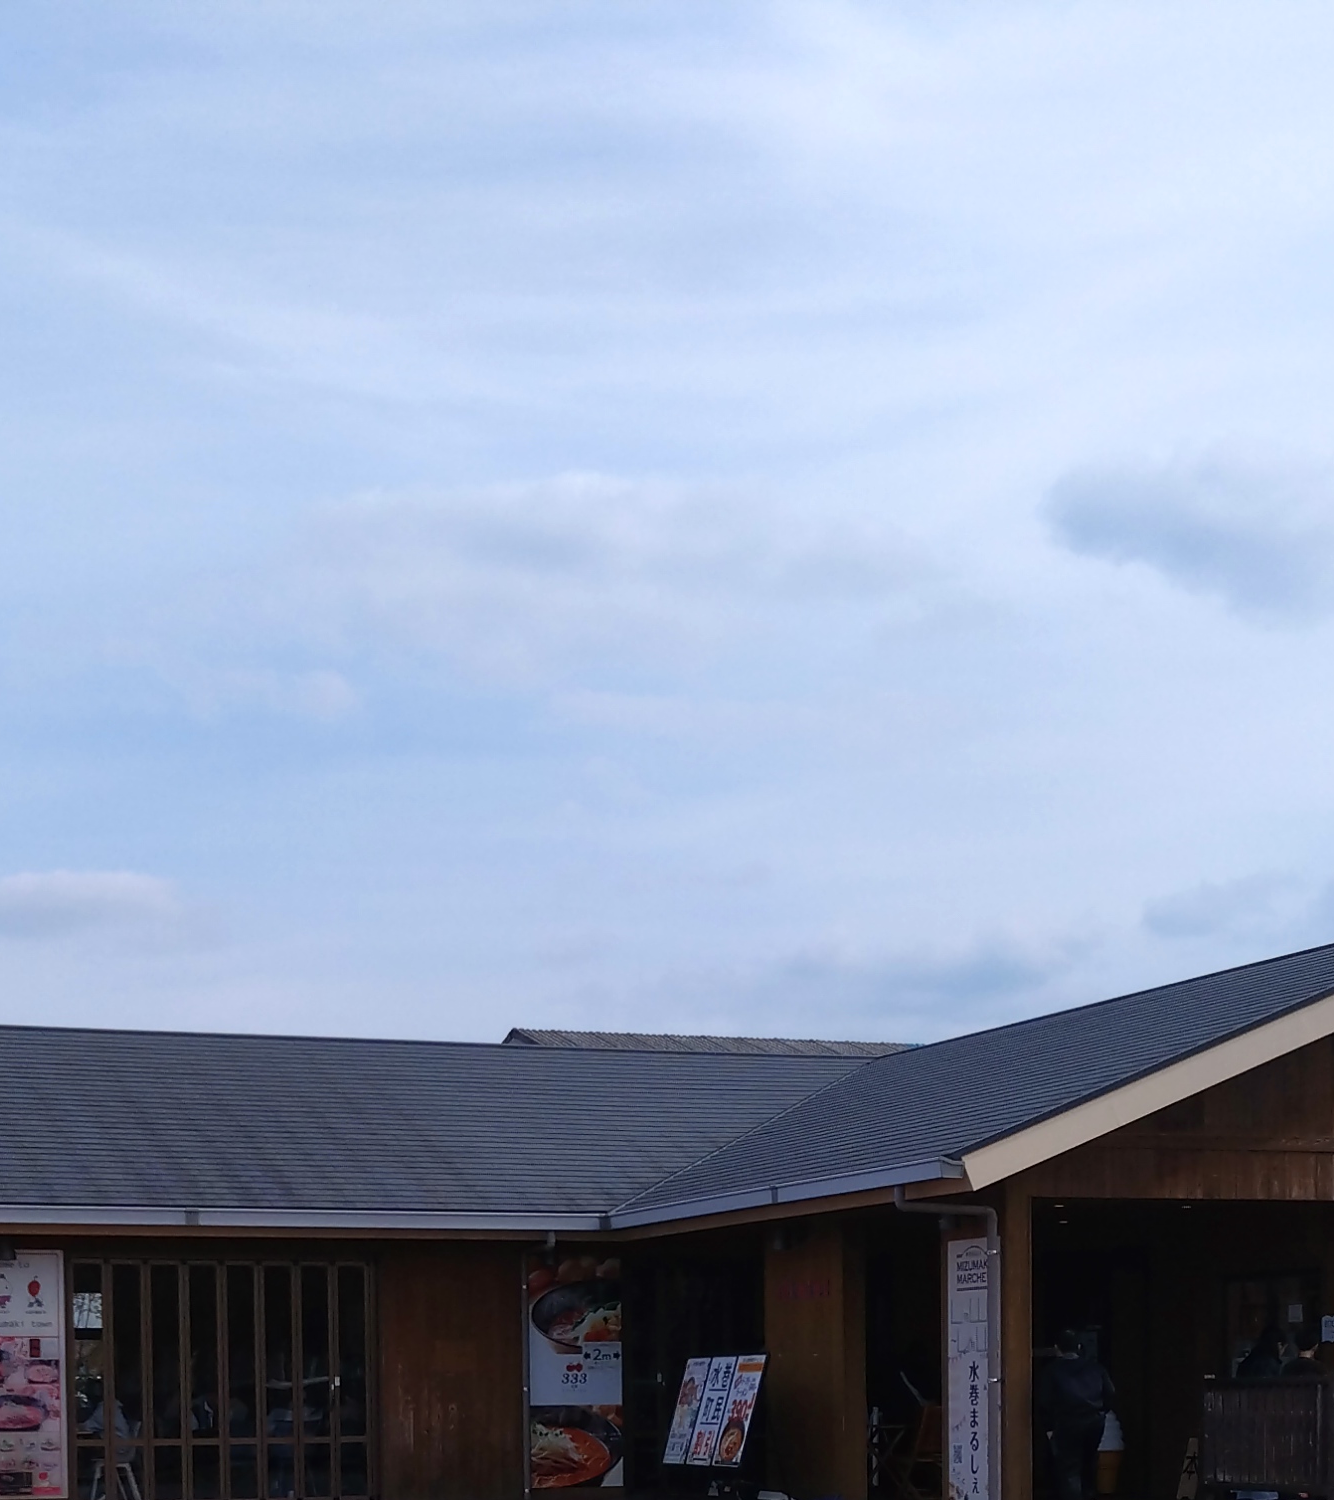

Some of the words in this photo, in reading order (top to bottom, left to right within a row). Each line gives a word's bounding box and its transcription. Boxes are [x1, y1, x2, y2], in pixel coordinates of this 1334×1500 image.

[956, 1258, 989, 1272] MIZUMAK
[956, 1271, 987, 1285] MARCHE
[31, 1319, 54, 1328] town
[592, 1348, 612, 1361] 2m
[561, 1372, 588, 1385] 333
[968, 1360, 980, 1494] 水巻まるしぇ
